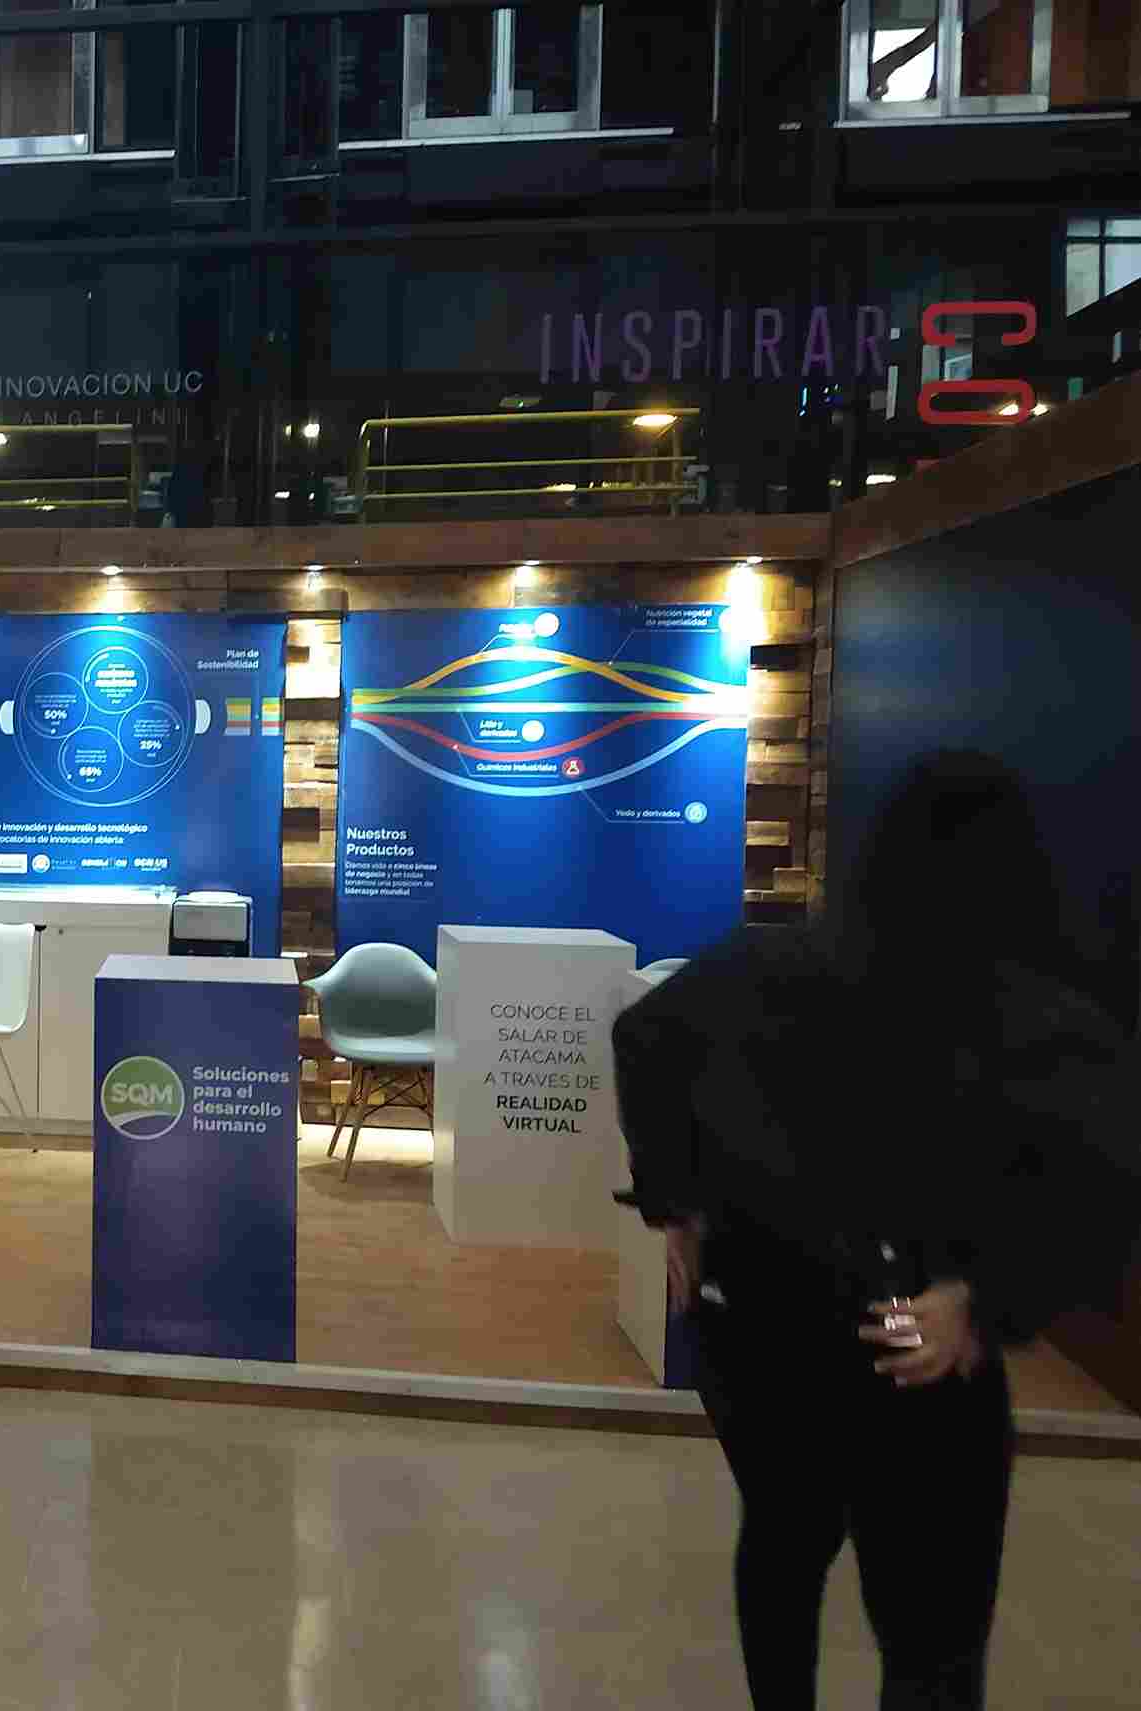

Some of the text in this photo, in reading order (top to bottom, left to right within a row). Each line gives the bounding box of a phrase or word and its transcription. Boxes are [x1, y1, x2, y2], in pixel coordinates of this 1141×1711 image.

[539, 305, 887, 385] INSPIRAR
[163, 370, 204, 395] UC
[247, 649, 259, 658] de
[197, 659, 259, 670] Sostenibilidad
[44, 709, 67, 720] 50%
[642, 809, 681, 817] derivados
[2, 822, 47, 833] innovación
[54, 822, 97, 833] desarrollo
[98, 823, 148, 834] tecnológico
[346, 827, 408, 840] Nuestros
[49, 834, 93, 844] innovación
[94, 835, 124, 844] abierta
[346, 843, 415, 857] Productos
[490, 1004, 596, 1022] CONOCE EL
[498, 1027, 587, 1045] SALAR DE
[498, 1049, 587, 1065] ATACAMA
[192, 1066, 290, 1083] Soluciones
[576, 1074, 601, 1090] DE
[111, 1082, 173, 1106] SQM
[193, 1085, 252, 1101] para el
[193, 1101, 282, 1117] desarrollo
[496, 1095, 587, 1112] REALIDAD
[193, 1116, 267, 1133] humano
[502, 1115, 582, 1133] VIRTUAL
